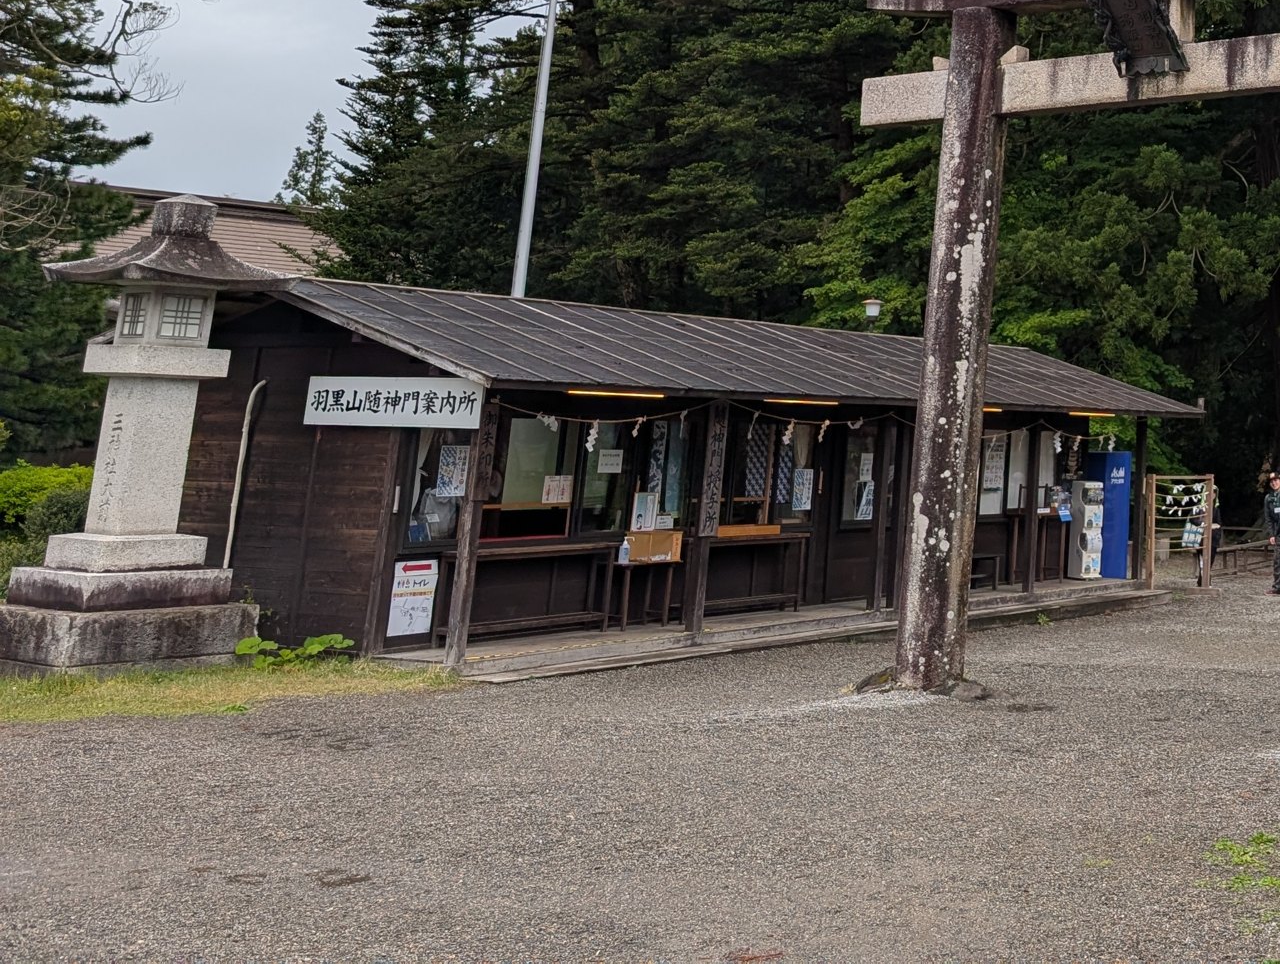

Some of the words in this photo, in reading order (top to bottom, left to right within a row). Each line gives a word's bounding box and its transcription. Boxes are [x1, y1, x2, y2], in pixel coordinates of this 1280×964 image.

[310, 388, 478, 416] 羽黒山随神門案内所
[412, 578, 430, 588] トイレ
